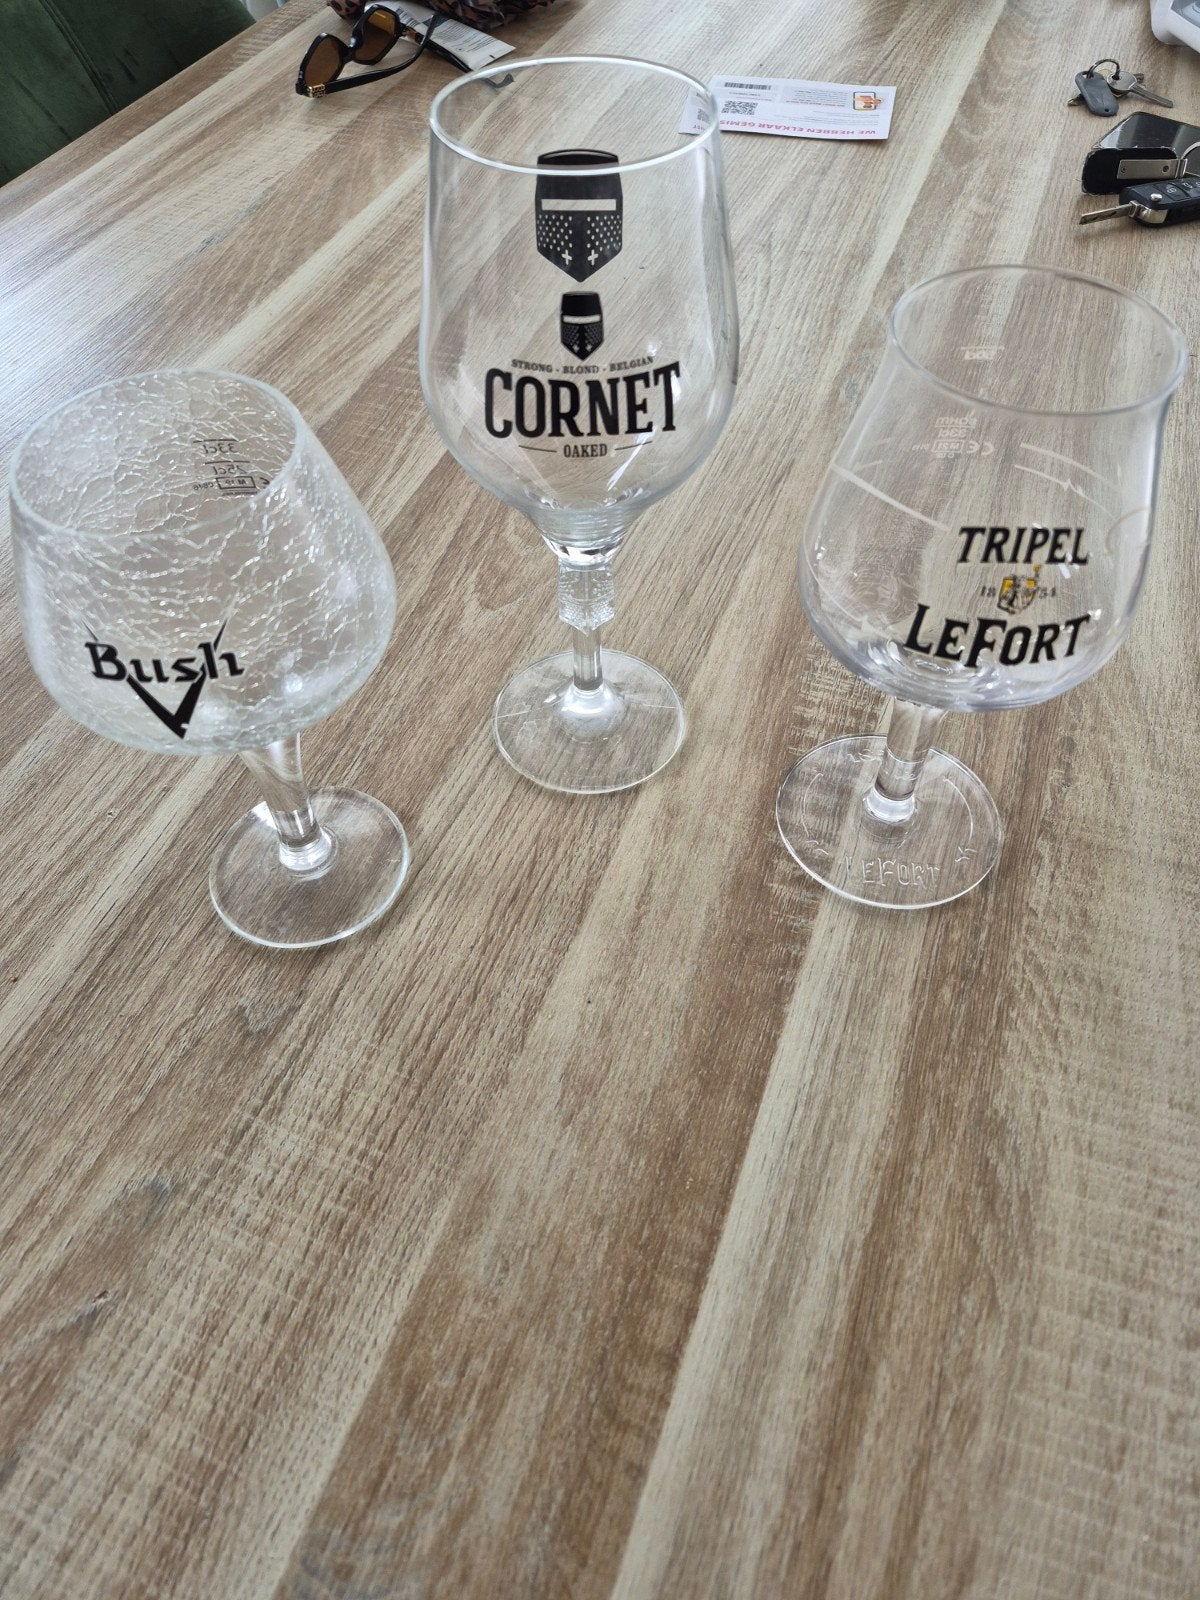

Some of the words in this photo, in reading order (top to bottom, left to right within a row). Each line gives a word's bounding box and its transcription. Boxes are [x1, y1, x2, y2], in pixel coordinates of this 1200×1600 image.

[719, 119, 756, 127] GEMIS
[758, 122, 804, 132] ELKAAR
[511, 358, 553, 374] STRONG
[562, 364, 600, 375] BLOND
[609, 355, 655, 373] BELGIAN
[484, 360, 681, 439] CORNET
[563, 443, 608, 459] OAKED
[956, 526, 1091, 565] TRIPEL
[84, 640, 246, 683] Bush
